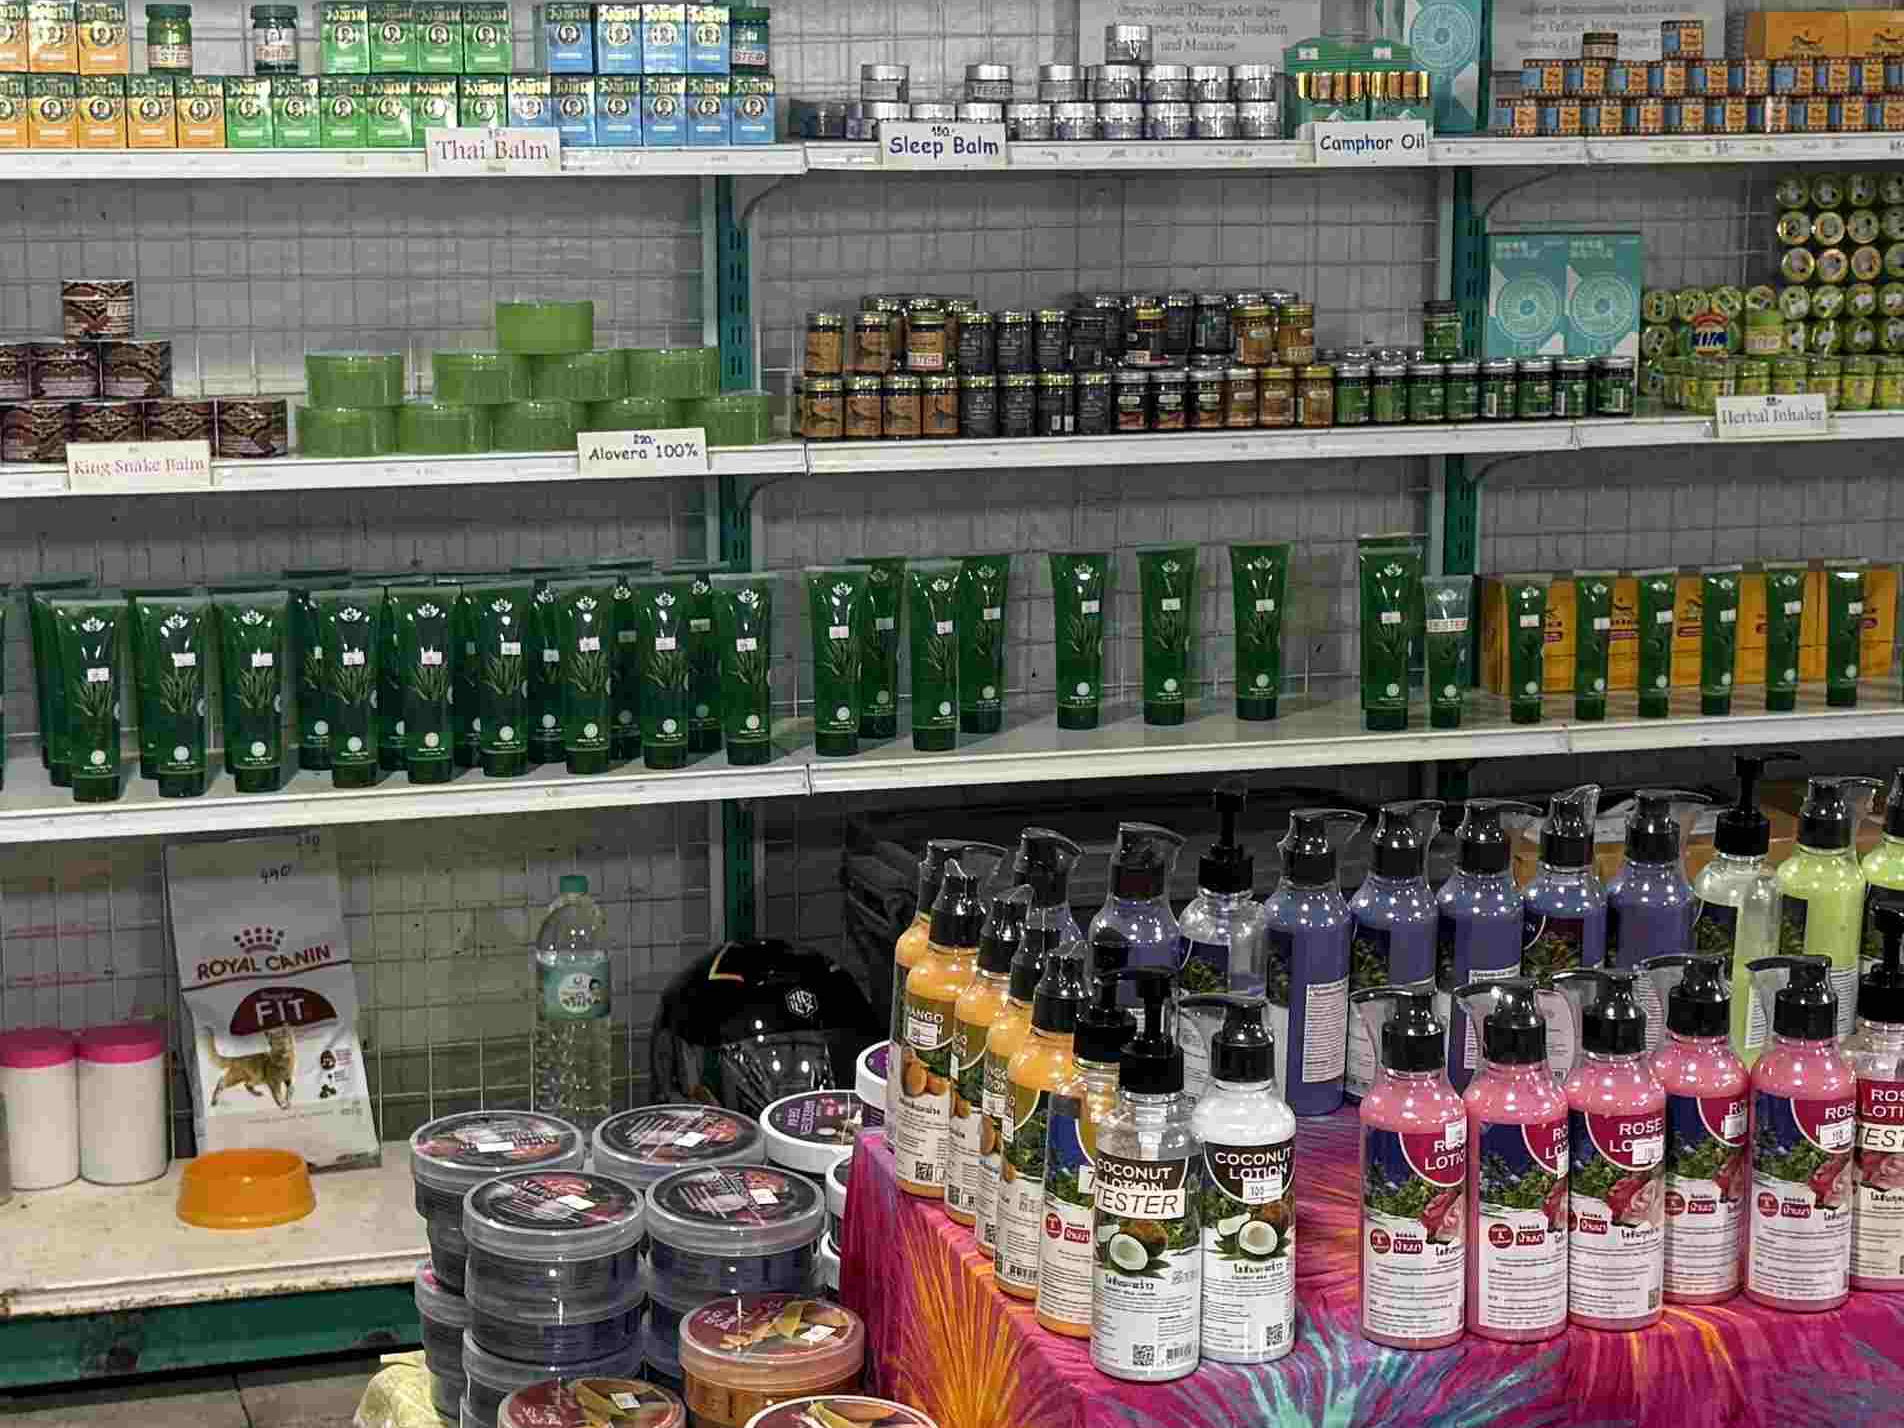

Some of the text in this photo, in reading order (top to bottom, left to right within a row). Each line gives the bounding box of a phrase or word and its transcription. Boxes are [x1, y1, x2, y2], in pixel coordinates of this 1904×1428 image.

[434, 139, 551, 160] Thai Balm
[889, 136, 1000, 158] Sleep Balm
[1320, 134, 1426, 156] Camphor Oil
[1721, 405, 1824, 428] Herbal Inhaler
[588, 442, 700, 463] Alovera 100%
[72, 455, 207, 479] King Snake Balm
[196, 944, 332, 982] ROYAL CANIN
[255, 997, 306, 1027] FIT
[1215, 1147, 1292, 1167] COCONUT
[1095, 1157, 1173, 1181] COCONUT
[1229, 1164, 1288, 1181] LOTION
